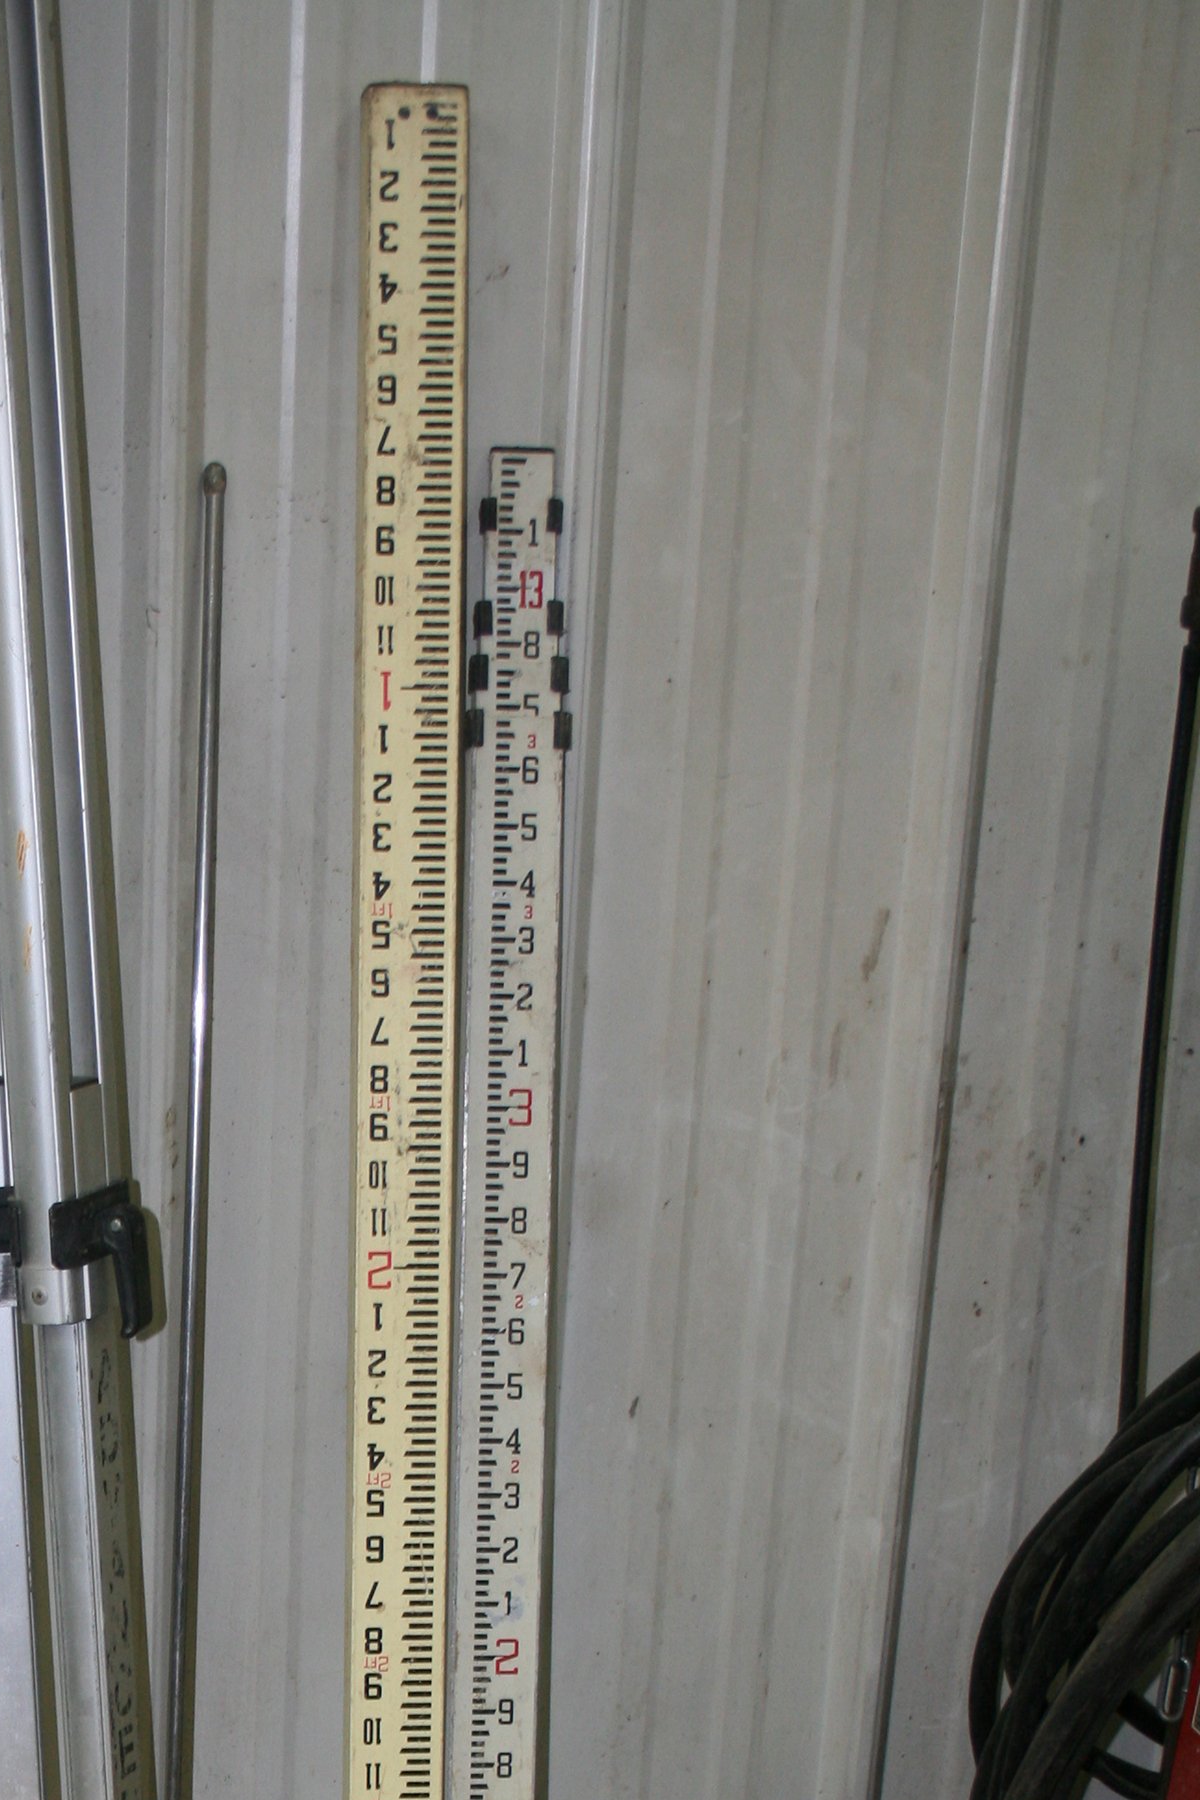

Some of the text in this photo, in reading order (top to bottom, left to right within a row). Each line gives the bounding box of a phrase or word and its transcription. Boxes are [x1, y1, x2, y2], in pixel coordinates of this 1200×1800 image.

[384, 119, 396, 151] 1
[380, 171, 399, 202] 2
[379, 222, 398, 253] 3
[379, 273, 398, 303] 4
[378, 324, 397, 355] 5
[377, 375, 397, 405] 6
[377, 426, 396, 456] 7
[376, 476, 395, 506] 8
[375, 525, 395, 556] 9
[528, 518, 539, 547] 1
[375, 576, 394, 605] 10
[518, 570, 544, 608] 13
[378, 625, 394, 655] 11
[523, 630, 540, 659] 8
[380, 671, 391, 710] 1
[378, 724, 388, 754] 1
[527, 734, 537, 749] 3
[521, 755, 539, 784] 6
[373, 774, 392, 803] 2
[372, 823, 391, 852] 3
[521, 813, 538, 841] 5
[372, 871, 391, 900] 4
[519, 869, 536, 898] 4
[524, 904, 533, 920] 3
[371, 920, 390, 949] 5
[518, 926, 535, 954] 3
[371, 968, 390, 997] 6
[516, 982, 533, 1011] 2
[370, 1017, 389, 1046] 7
[517, 1039, 529, 1067] 1
[370, 1065, 389, 1094] 8
[508, 1088, 533, 1126] 3
[370, 1113, 388, 1142] 9
[369, 1160, 388, 1189] 10
[512, 1150, 529, 1179] 9
[371, 1207, 387, 1237] 11
[511, 1206, 527, 1234] 8
[367, 1250, 392, 1290] 2
[510, 1262, 526, 1289] 7
[514, 1294, 524, 1309] 2
[372, 1302, 383, 1331] 1
[508, 1317, 525, 1345] 6
[368, 1350, 387, 1378] 2
[506, 1372, 523, 1400] 5
[367, 1397, 386, 1425] 3
[505, 1427, 522, 1455] 4
[366, 1443, 385, 1471] 4
[510, 1459, 520, 1474] 2
[366, 1489, 385, 1517] 5
[504, 1482, 520, 1510] 3
[366, 1536, 384, 1563] 6
[502, 1536, 519, 1564] 2
[365, 1581, 383, 1610] 7
[504, 1591, 512, 1616] 1
[364, 1627, 383, 1655] 8
[495, 1638, 519, 1675] 2
[364, 1672, 382, 1700] 9
[498, 1698, 514, 1725] 9
[363, 1717, 382, 1745] 10
[365, 1763, 381, 1790] 11
[496, 1752, 513, 1778] 8
